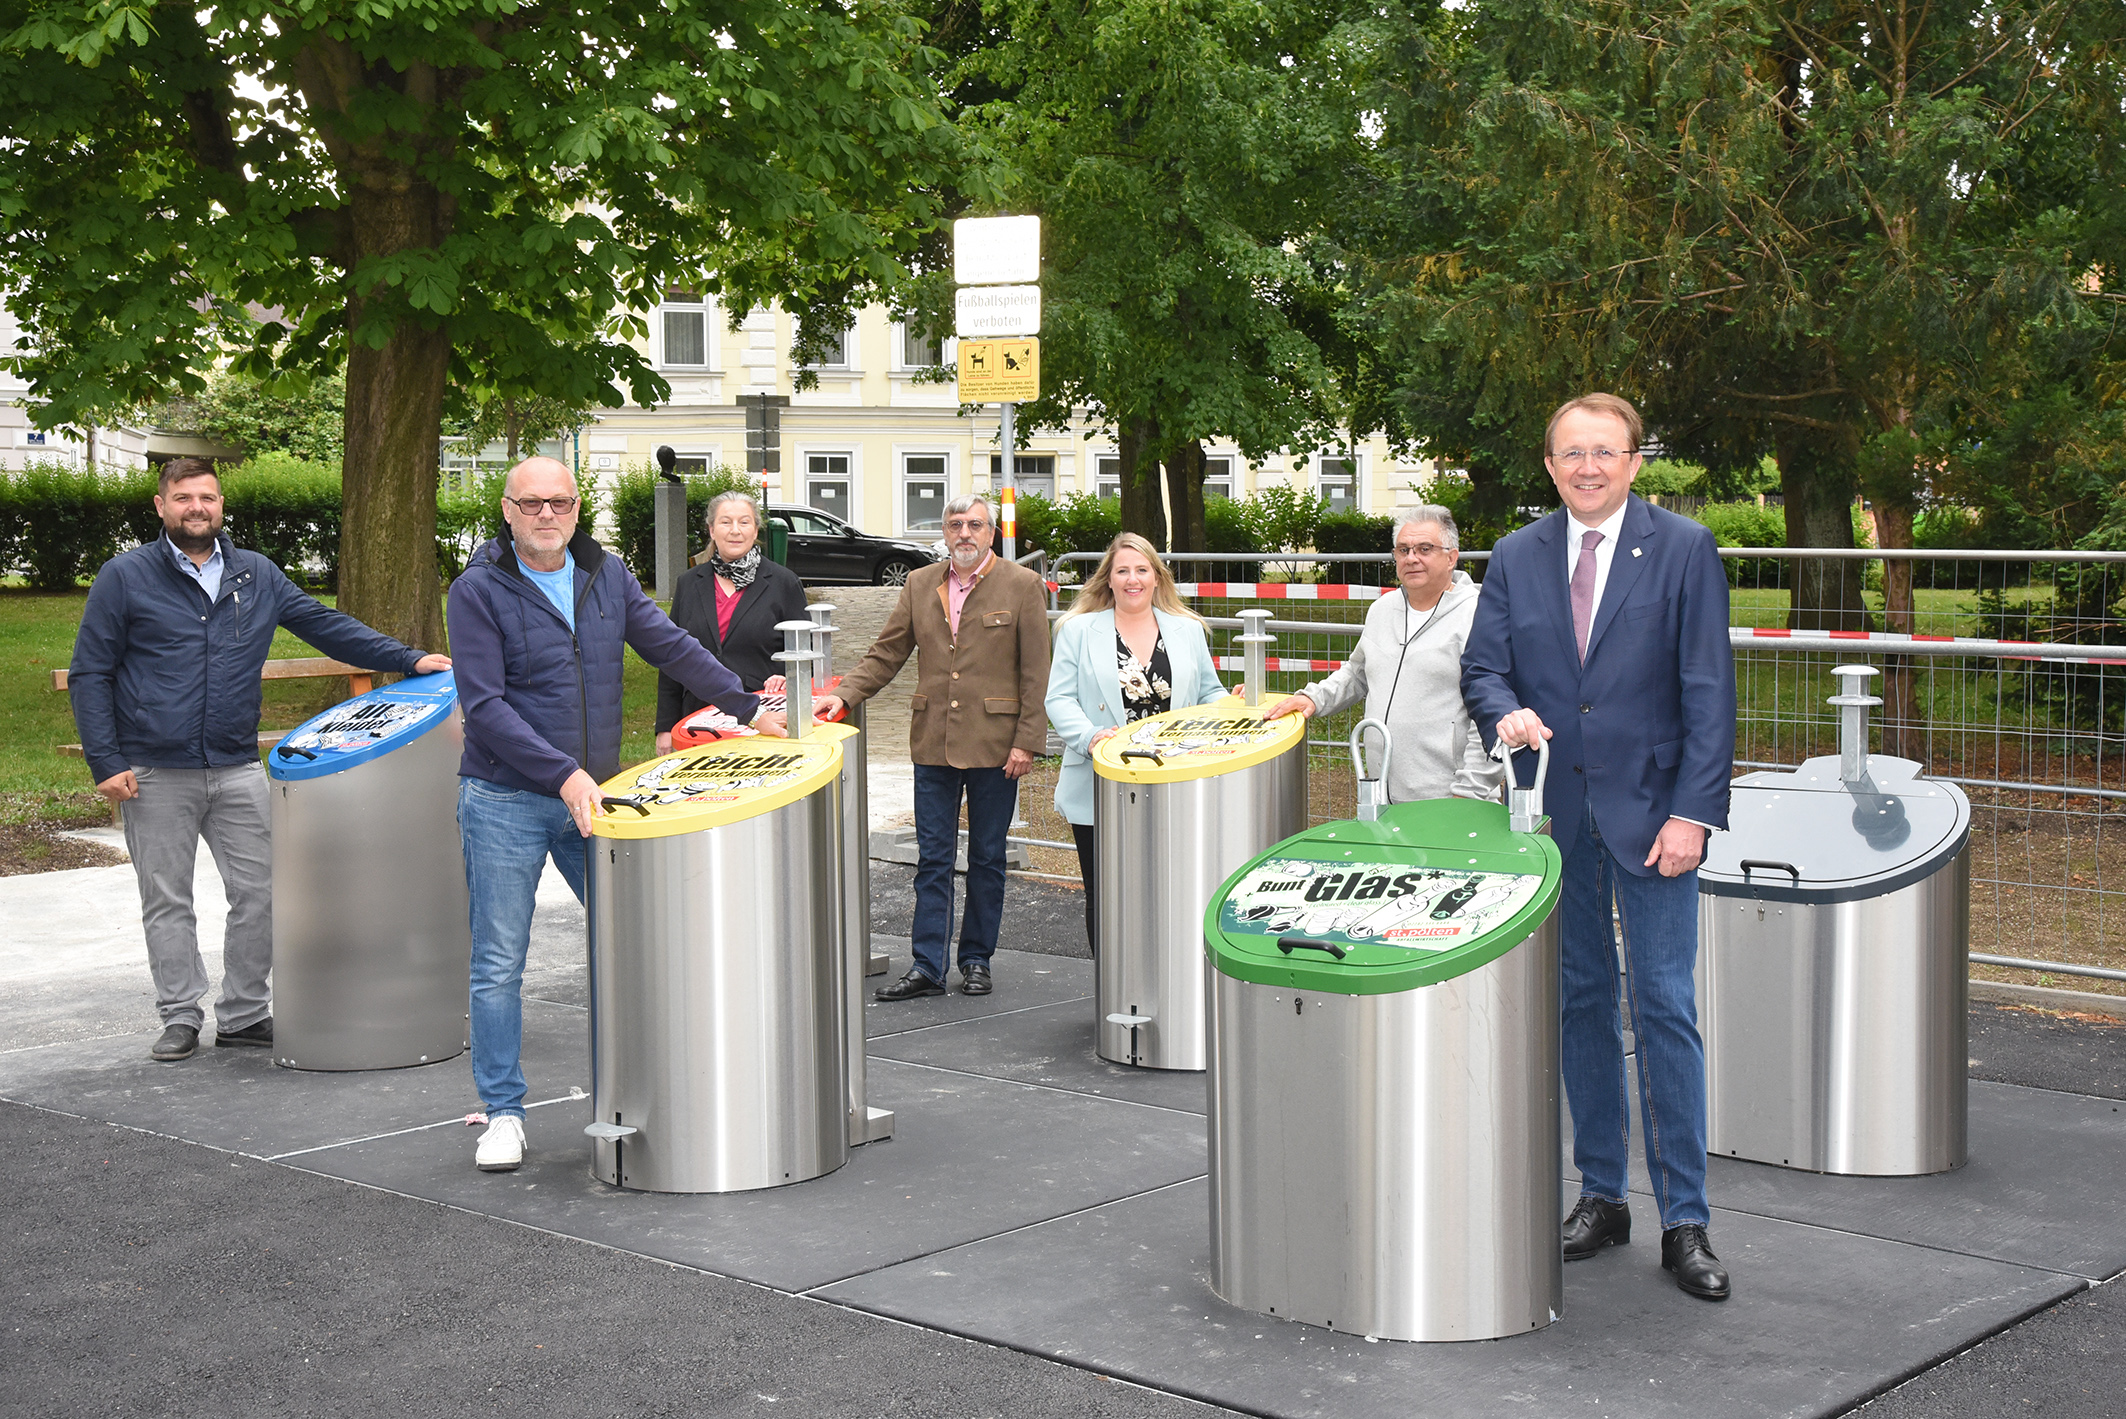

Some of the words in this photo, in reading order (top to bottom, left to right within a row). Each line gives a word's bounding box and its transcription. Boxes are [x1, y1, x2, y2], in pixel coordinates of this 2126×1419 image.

[958, 293, 1037, 308] Fußballspielen
[973, 315, 1022, 327] verboten
[348, 703, 396, 720] Alt
[317, 719, 394, 734] Kleider
[1165, 717, 1269, 731] Leicht
[680, 753, 804, 770] Leicht
[668, 769, 791, 779] Verpackungen
[1256, 879, 1306, 893] Bunt
[1389, 928, 1454, 937] st.pölten
